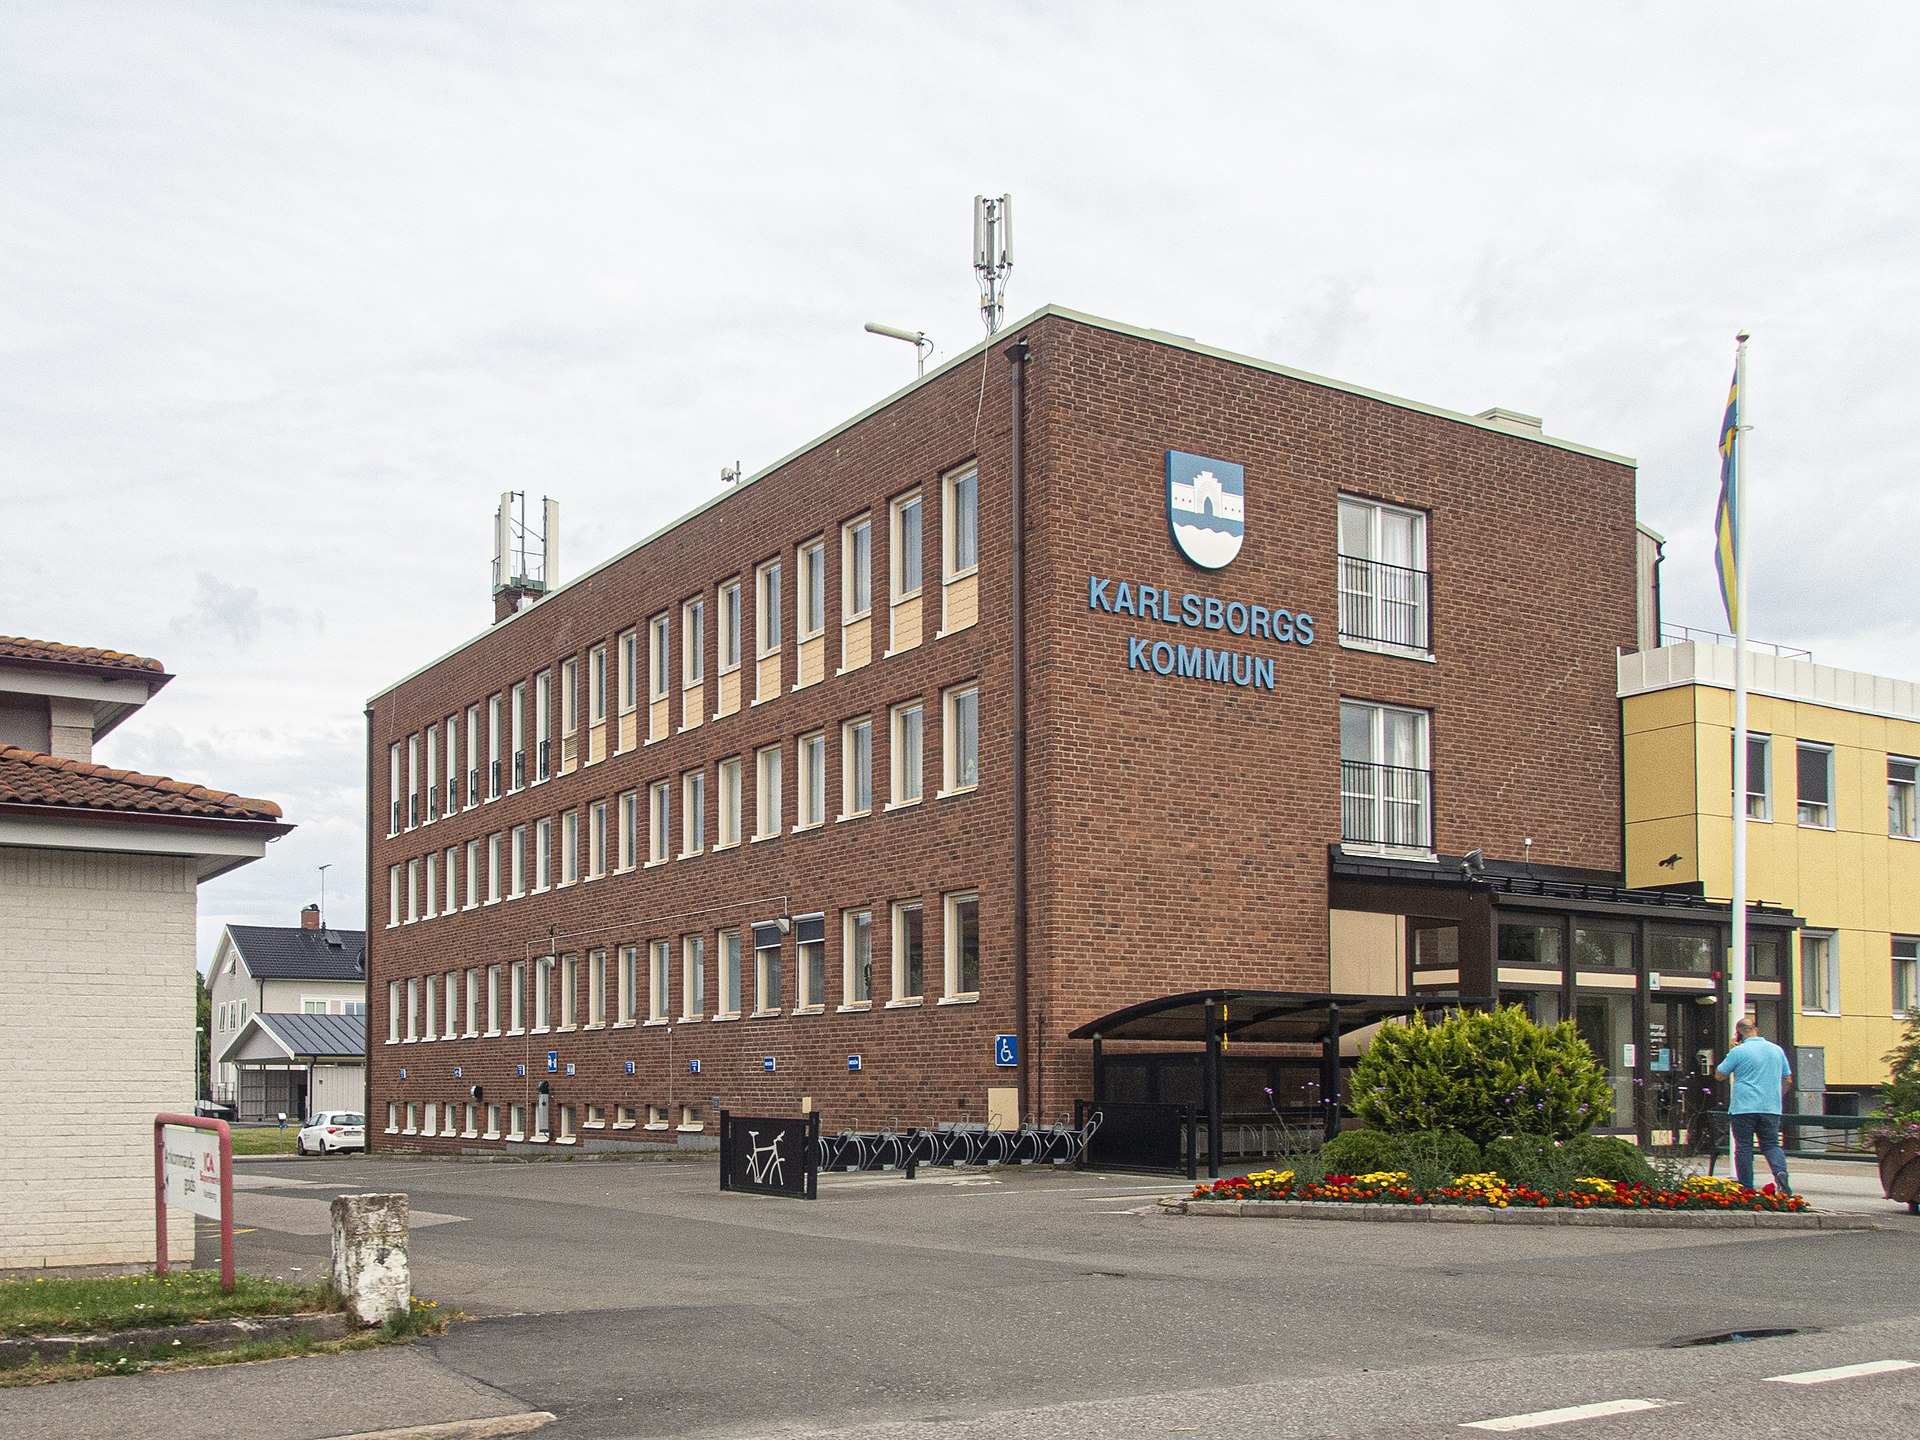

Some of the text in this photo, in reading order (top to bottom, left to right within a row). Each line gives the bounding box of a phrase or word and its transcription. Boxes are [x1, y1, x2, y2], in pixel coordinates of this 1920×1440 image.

[1089, 575, 1315, 646] KARLSBORGS
[1128, 636, 1275, 690] KOMMUN
[203, 1151, 215, 1173] ICA
